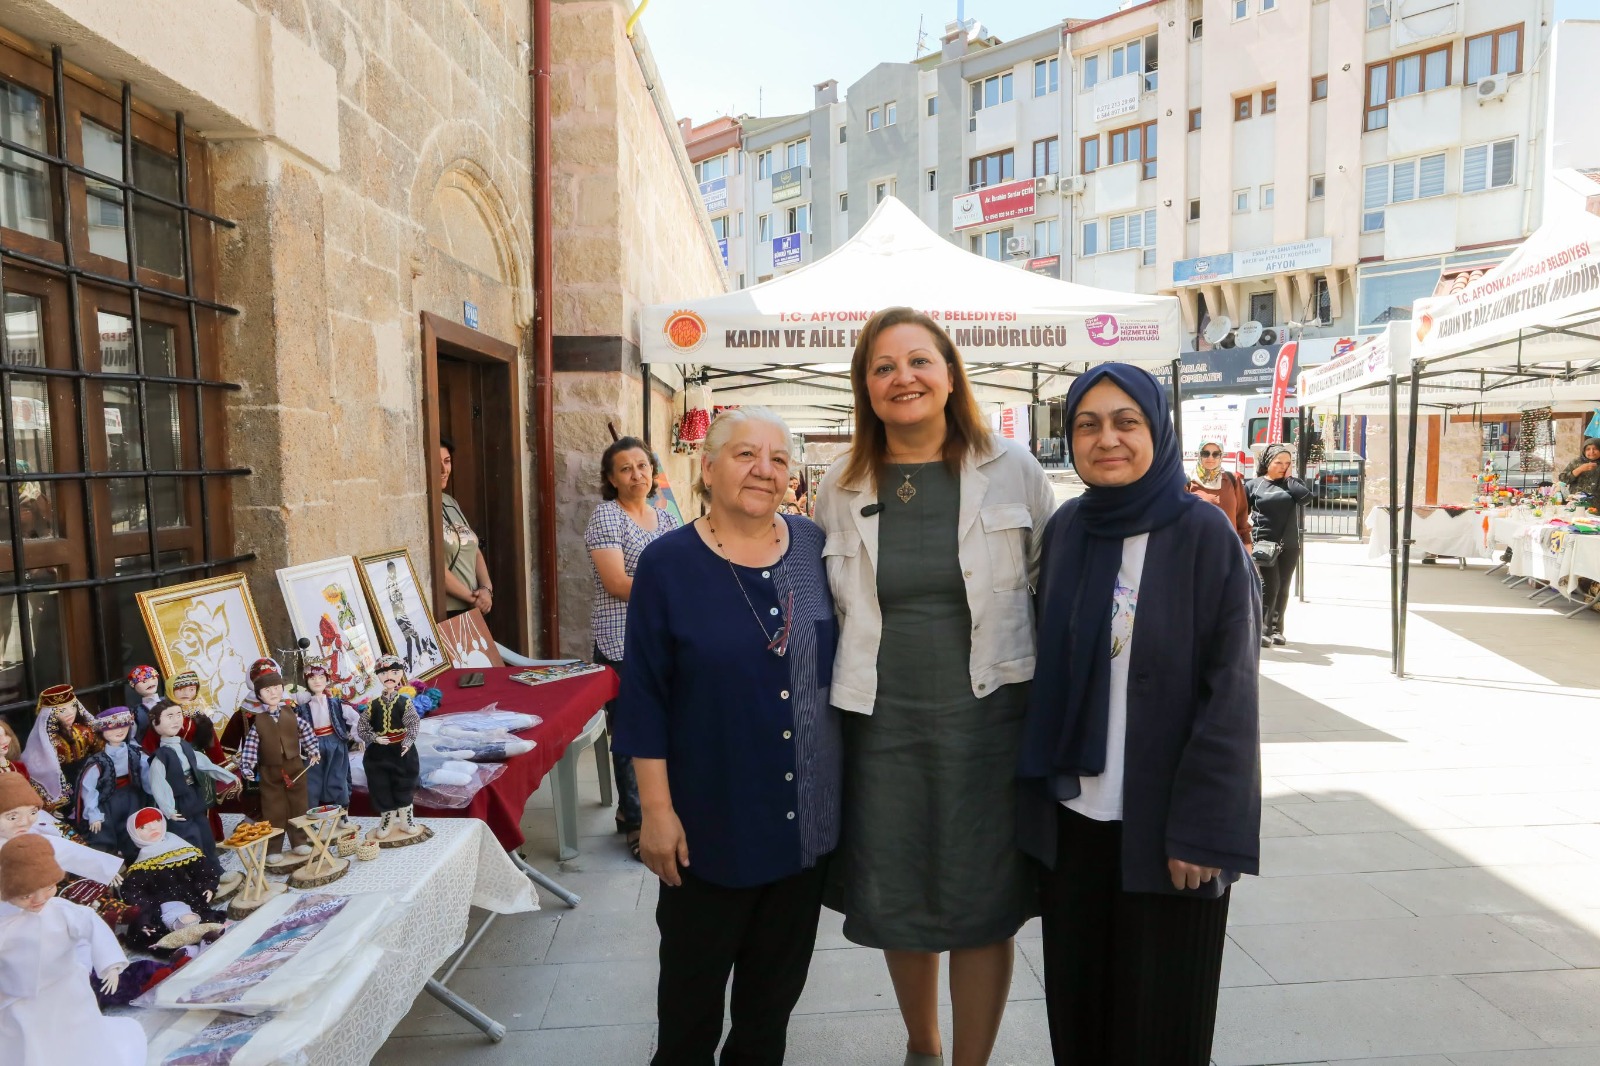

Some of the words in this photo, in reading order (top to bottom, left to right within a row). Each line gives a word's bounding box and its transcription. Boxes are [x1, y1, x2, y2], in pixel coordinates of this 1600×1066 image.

[1266, 260, 1296, 271] AFYON
[1437, 315, 1460, 339] KADIN
[1462, 310, 1472, 332] VE
[1549, 262, 1600, 302] MÜDÜR
[1456, 295, 1471, 306] T.C.
[779, 312, 805, 322] T.C.
[725, 329, 779, 348] KADIN
[784, 329, 805, 348] VE
[809, 325, 845, 348] AİLE
[956, 325, 1066, 347] MÜDÜRLÜĞÜ
